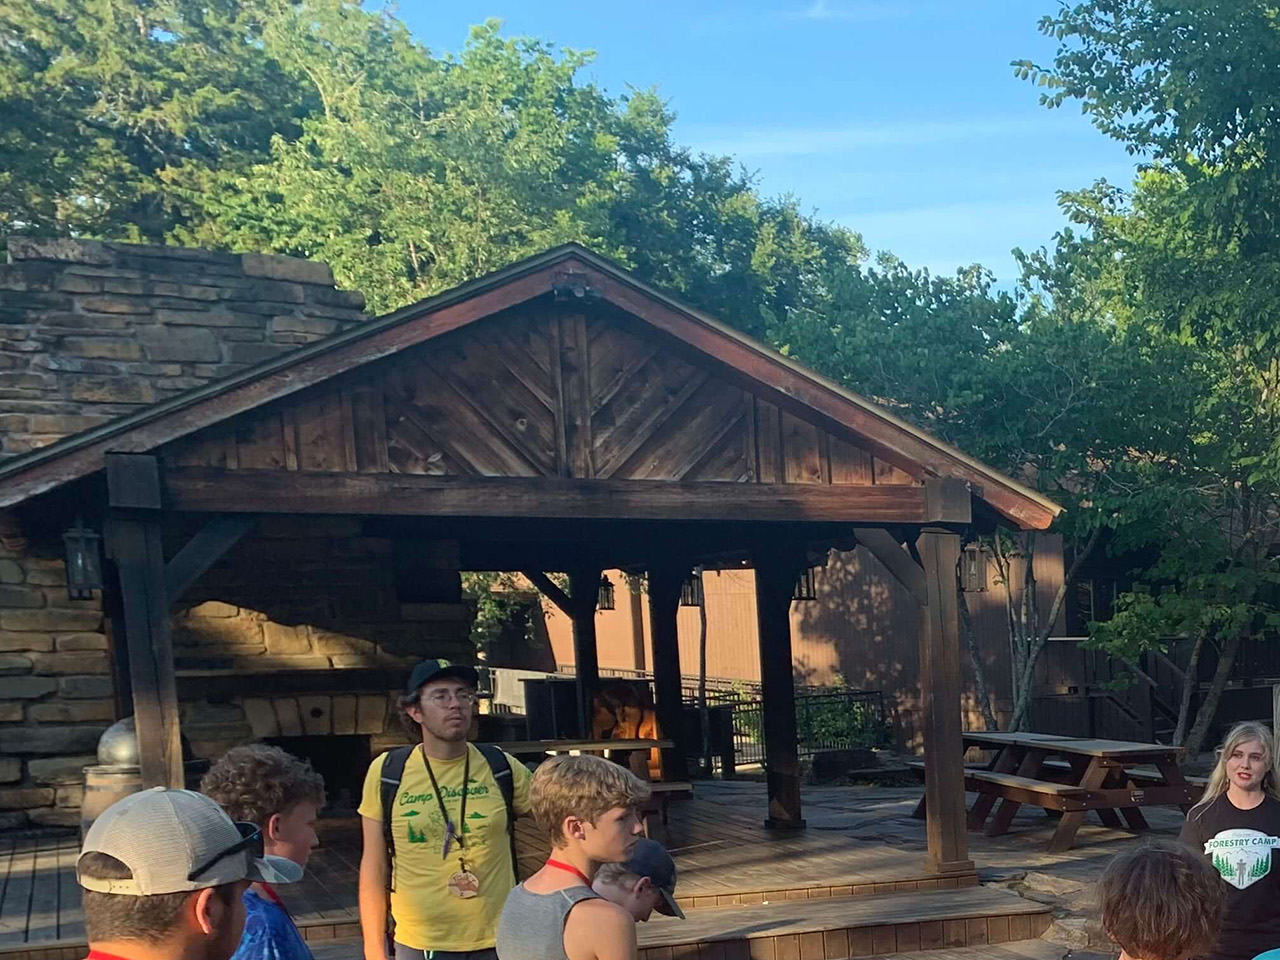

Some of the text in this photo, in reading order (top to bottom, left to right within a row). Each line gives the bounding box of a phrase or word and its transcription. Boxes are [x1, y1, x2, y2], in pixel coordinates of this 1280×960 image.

[400, 791, 433, 806] Camp
[438, 785, 489, 799] Discver
[1209, 837, 1277, 849] FORESTRY CAMP
